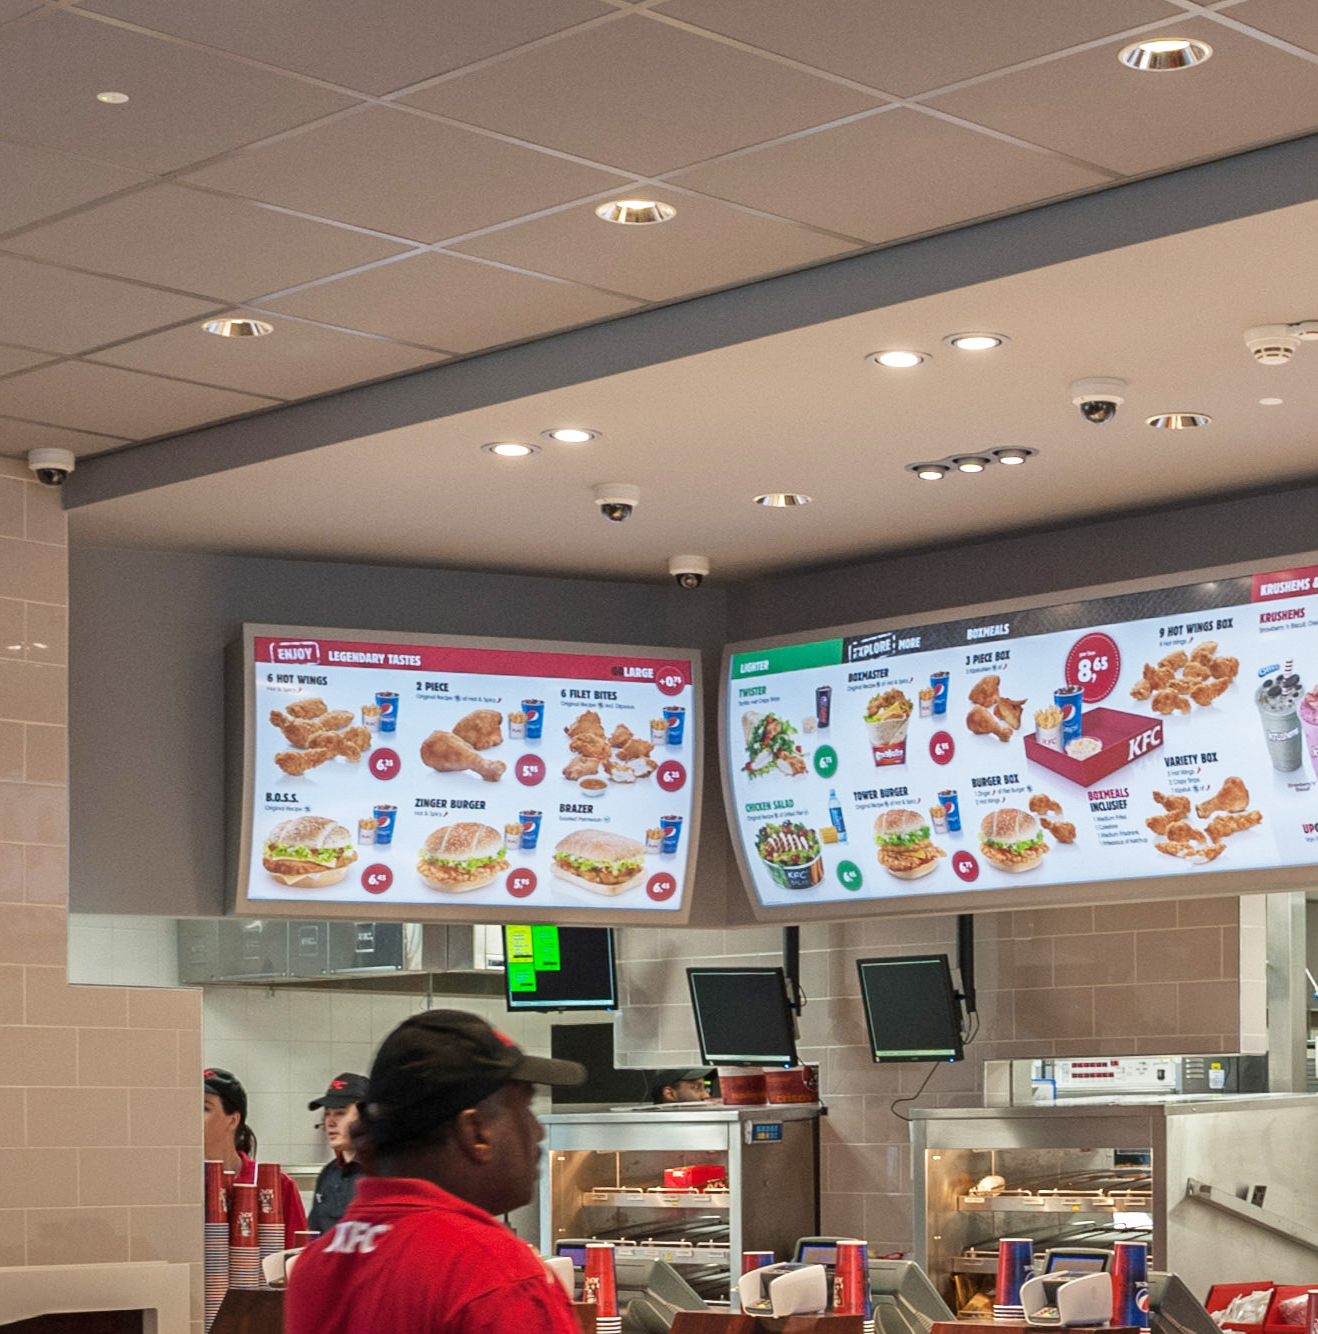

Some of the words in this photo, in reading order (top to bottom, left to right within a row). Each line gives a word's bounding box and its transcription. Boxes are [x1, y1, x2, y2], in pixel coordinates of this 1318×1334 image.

[1260, 577, 1310, 596] KRUSHEMS
[1259, 607, 1305, 624] KRUSHEMS
[967, 623, 1010, 640] BOXMEALS
[1159, 628, 1165, 638] 9
[1168, 626, 1183, 637] HOT
[1187, 621, 1213, 634] WINGS
[1216, 618, 1234, 629] BOX
[852, 639, 891, 659] EXPLORE
[898, 636, 921, 650] MORE
[277, 647, 313, 660] ENJOY
[328, 650, 385, 664] LEGENDARY
[388, 654, 422, 666] TASTES
[965, 656, 971, 665] 3
[973, 652, 992, 664] PIECE
[995, 650, 1010, 661] BOX
[740, 660, 769, 673] LIGHTER
[1078, 657, 1109, 685] 8,65
[267, 674, 273, 683] 6
[277, 674, 293, 684] HOT
[297, 675, 328, 686] WINGS
[848, 668, 889, 682] BOXMASTER
[416, 681, 422, 691] 2
[425, 682, 449, 692] PIECE
[738, 686, 766, 698] TWISTER
[560, 689, 566, 698] 6
[569, 690, 590, 699] FILET
[594, 690, 617, 700] BITES
[1128, 725, 1162, 761] KFC
[1164, 754, 1198, 767] VARIETY
[1201, 752, 1218, 764] BOX
[971, 776, 1002, 788] BURGER
[1004, 774, 1020, 785] BOX
[853, 789, 878, 802] TOWER
[880, 786, 909, 799] BURGER
[1088, 788, 1129, 801] BOXMEALS
[415, 798, 447, 808] ZINGER
[450, 800, 486, 810] BURGER
[559, 803, 594, 814] BRAZER
[745, 801, 771, 812] CHICKEN
[773, 799, 794, 810] SALAD
[1090, 799, 1128, 812] INCLUSIEF
[322, 1220, 394, 1254] KFC
